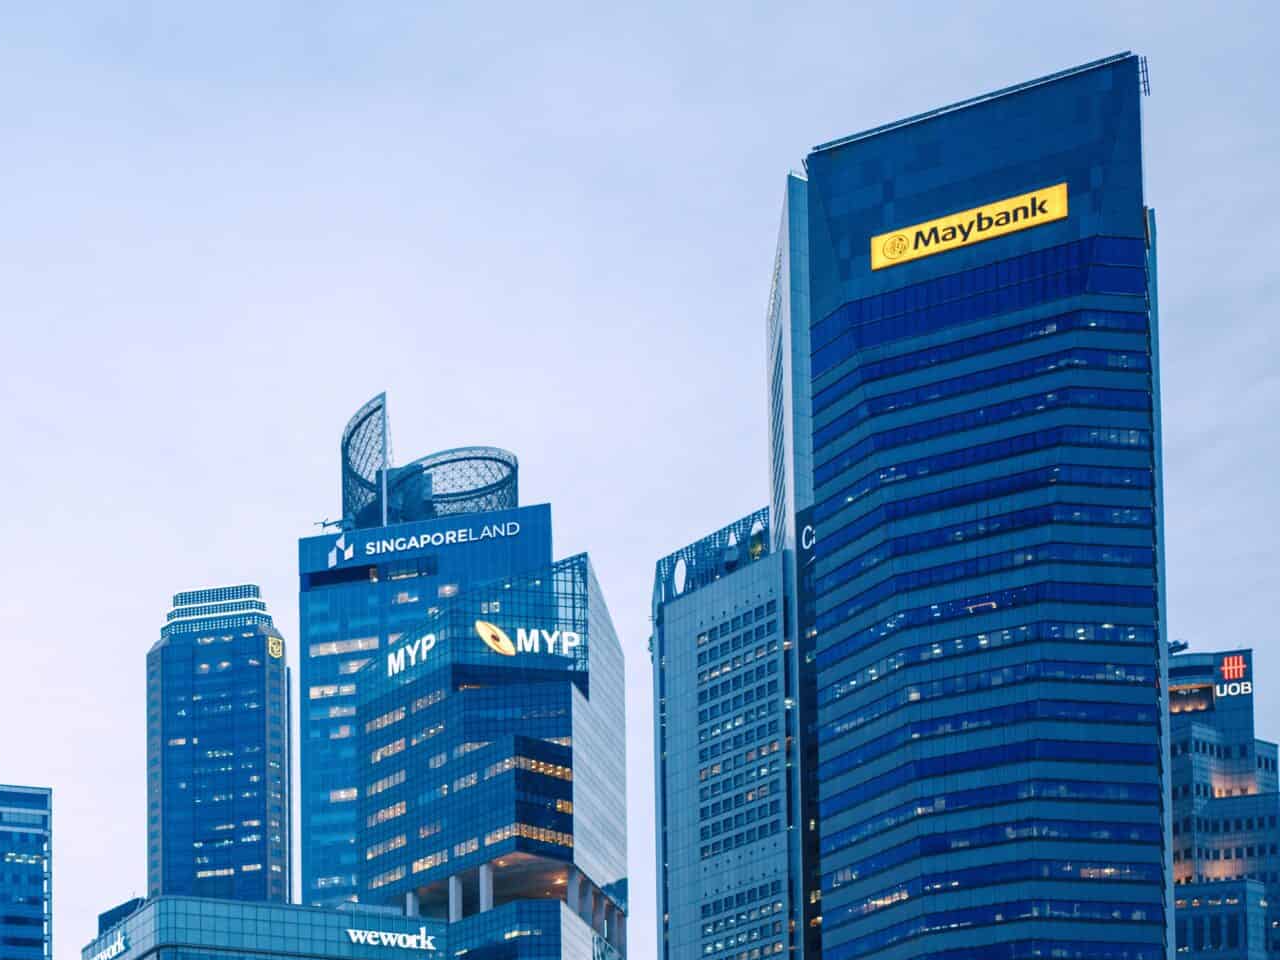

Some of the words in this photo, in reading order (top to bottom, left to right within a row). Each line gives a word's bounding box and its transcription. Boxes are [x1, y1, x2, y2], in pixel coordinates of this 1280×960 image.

[913, 196, 1048, 250] Maybank
[365, 521, 520, 555] SINGAPORELAND
[387, 633, 436, 677] MYP
[517, 628, 581, 655] MYP
[1215, 681, 1252, 697] UOB
[346, 926, 437, 951] wework
